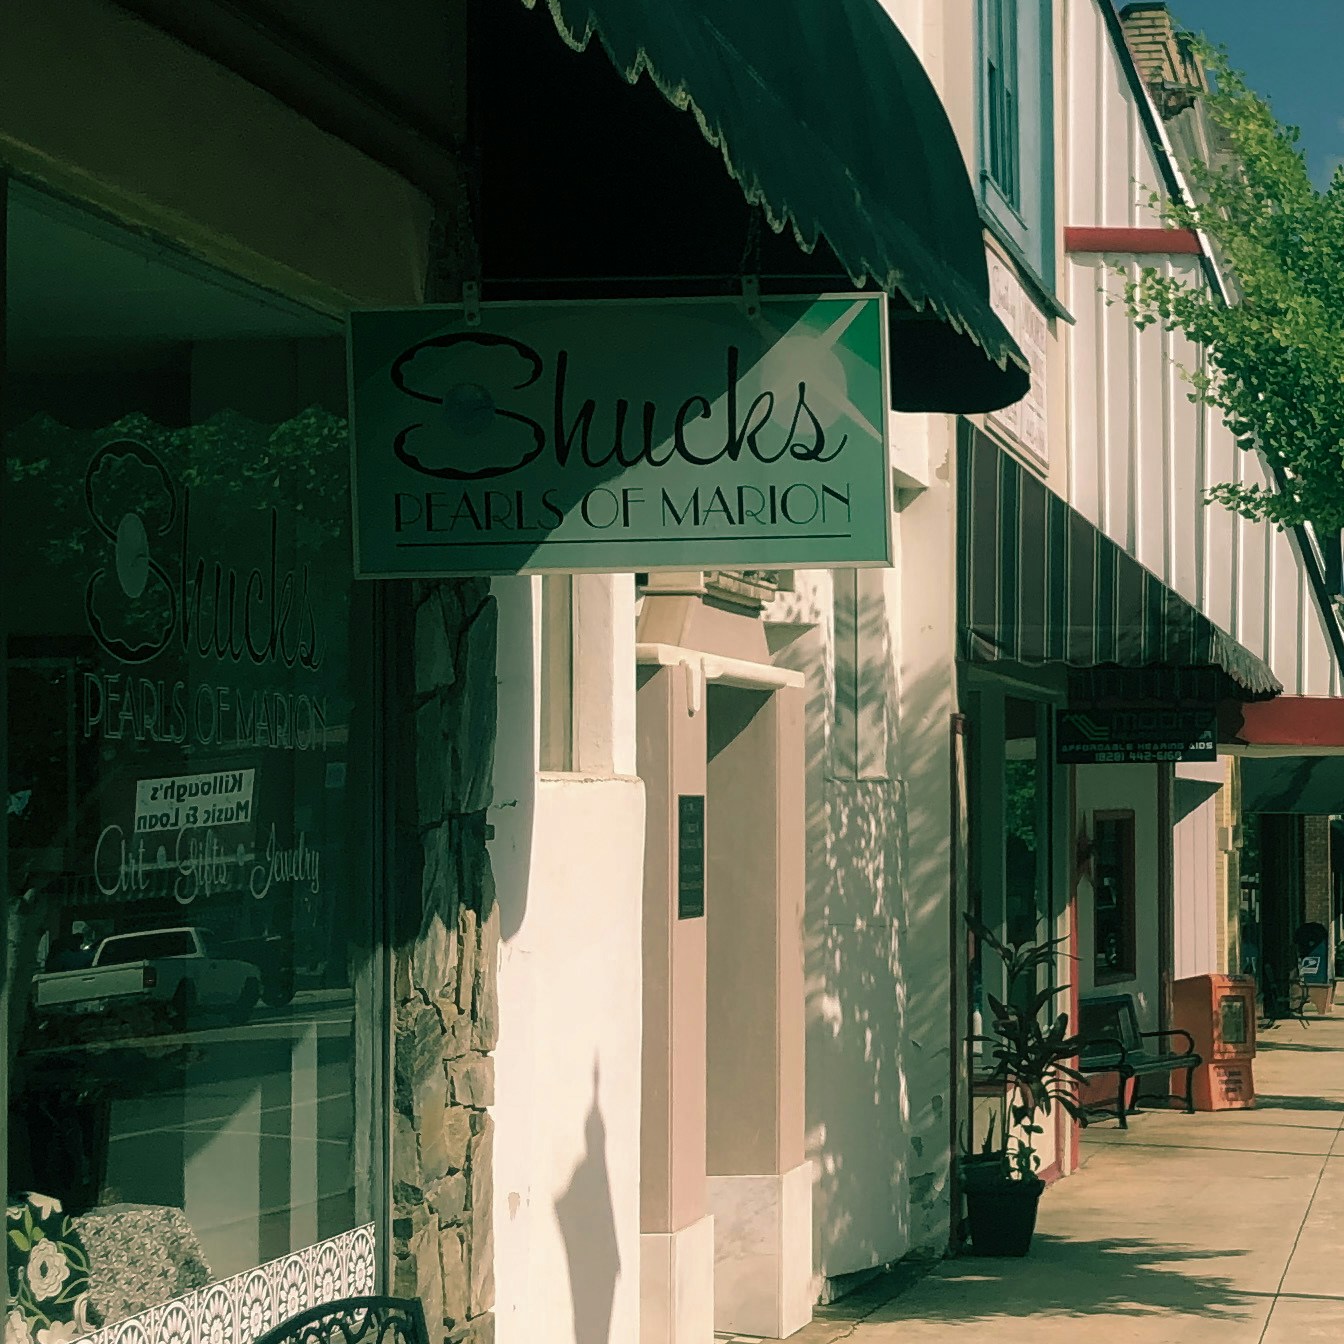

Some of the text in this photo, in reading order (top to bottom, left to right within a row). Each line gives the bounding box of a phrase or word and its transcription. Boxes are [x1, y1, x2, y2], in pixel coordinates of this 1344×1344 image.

[390, 331, 848, 481] Shucks
[393, 483, 852, 533] PEARLS OF MARION
[84, 438, 325, 672] Shucks
[83, 672, 328, 752] PEARLS OF MARION
[1061, 741, 1213, 752] AFFORDABLE HEARING AIDS
[94, 824, 150, 896] Art
[173, 822, 229, 906] Gifts
